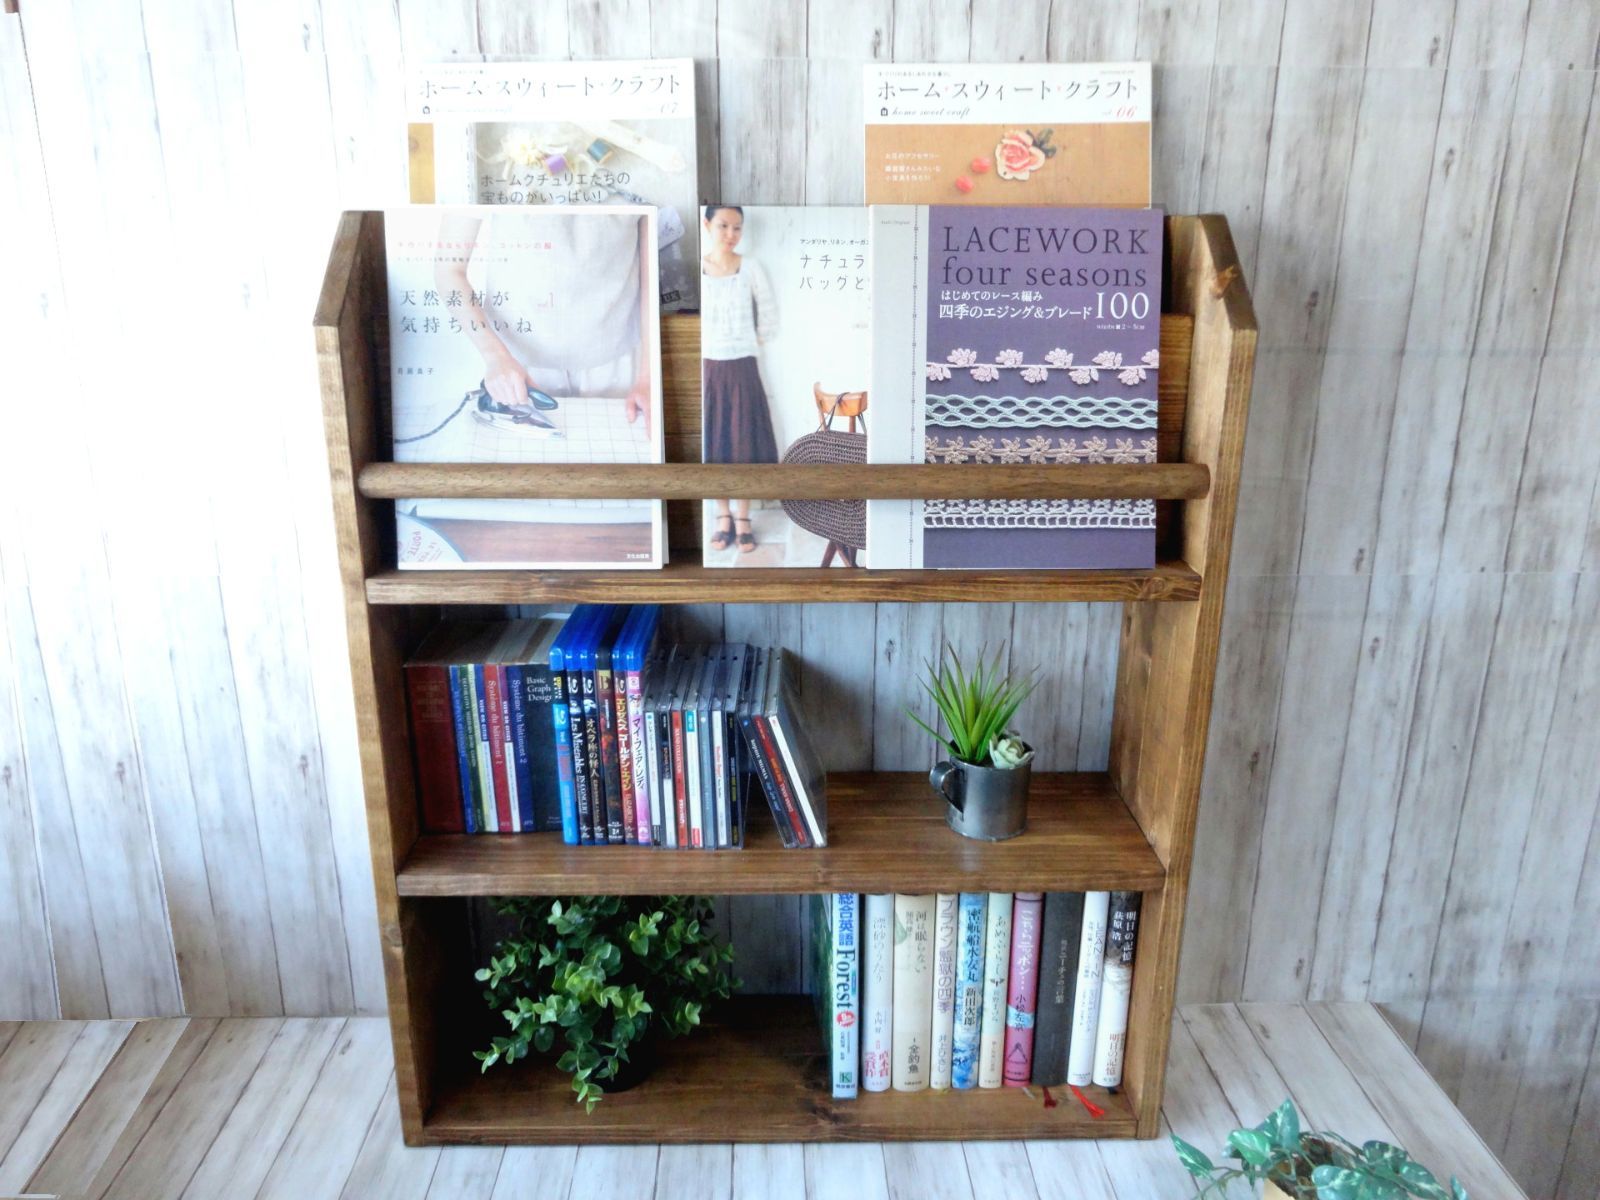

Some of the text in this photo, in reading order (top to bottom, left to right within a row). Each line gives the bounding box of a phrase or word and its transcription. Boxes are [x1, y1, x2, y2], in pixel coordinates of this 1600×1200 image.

[943, 226, 1149, 255] LACEWORK
[800, 254, 865, 270] ナチュラ
[943, 256, 1147, 288] four seasons
[799, 276, 865, 291] バッグと
[400, 289, 509, 308] 天然素材が
[941, 289, 1043, 303] はじめてのレース編み
[1095, 291, 1150, 320] 100
[939, 303, 1093, 320] 四季のエジング&ブレード
[401, 315, 532, 334] 気持ちいいね
[570, 717, 582, 732] Les
[1122, 911, 1137, 961] 明日の記憶
[836, 949, 856, 1008] Forest
[963, 986, 977, 1026] 新田次郎
